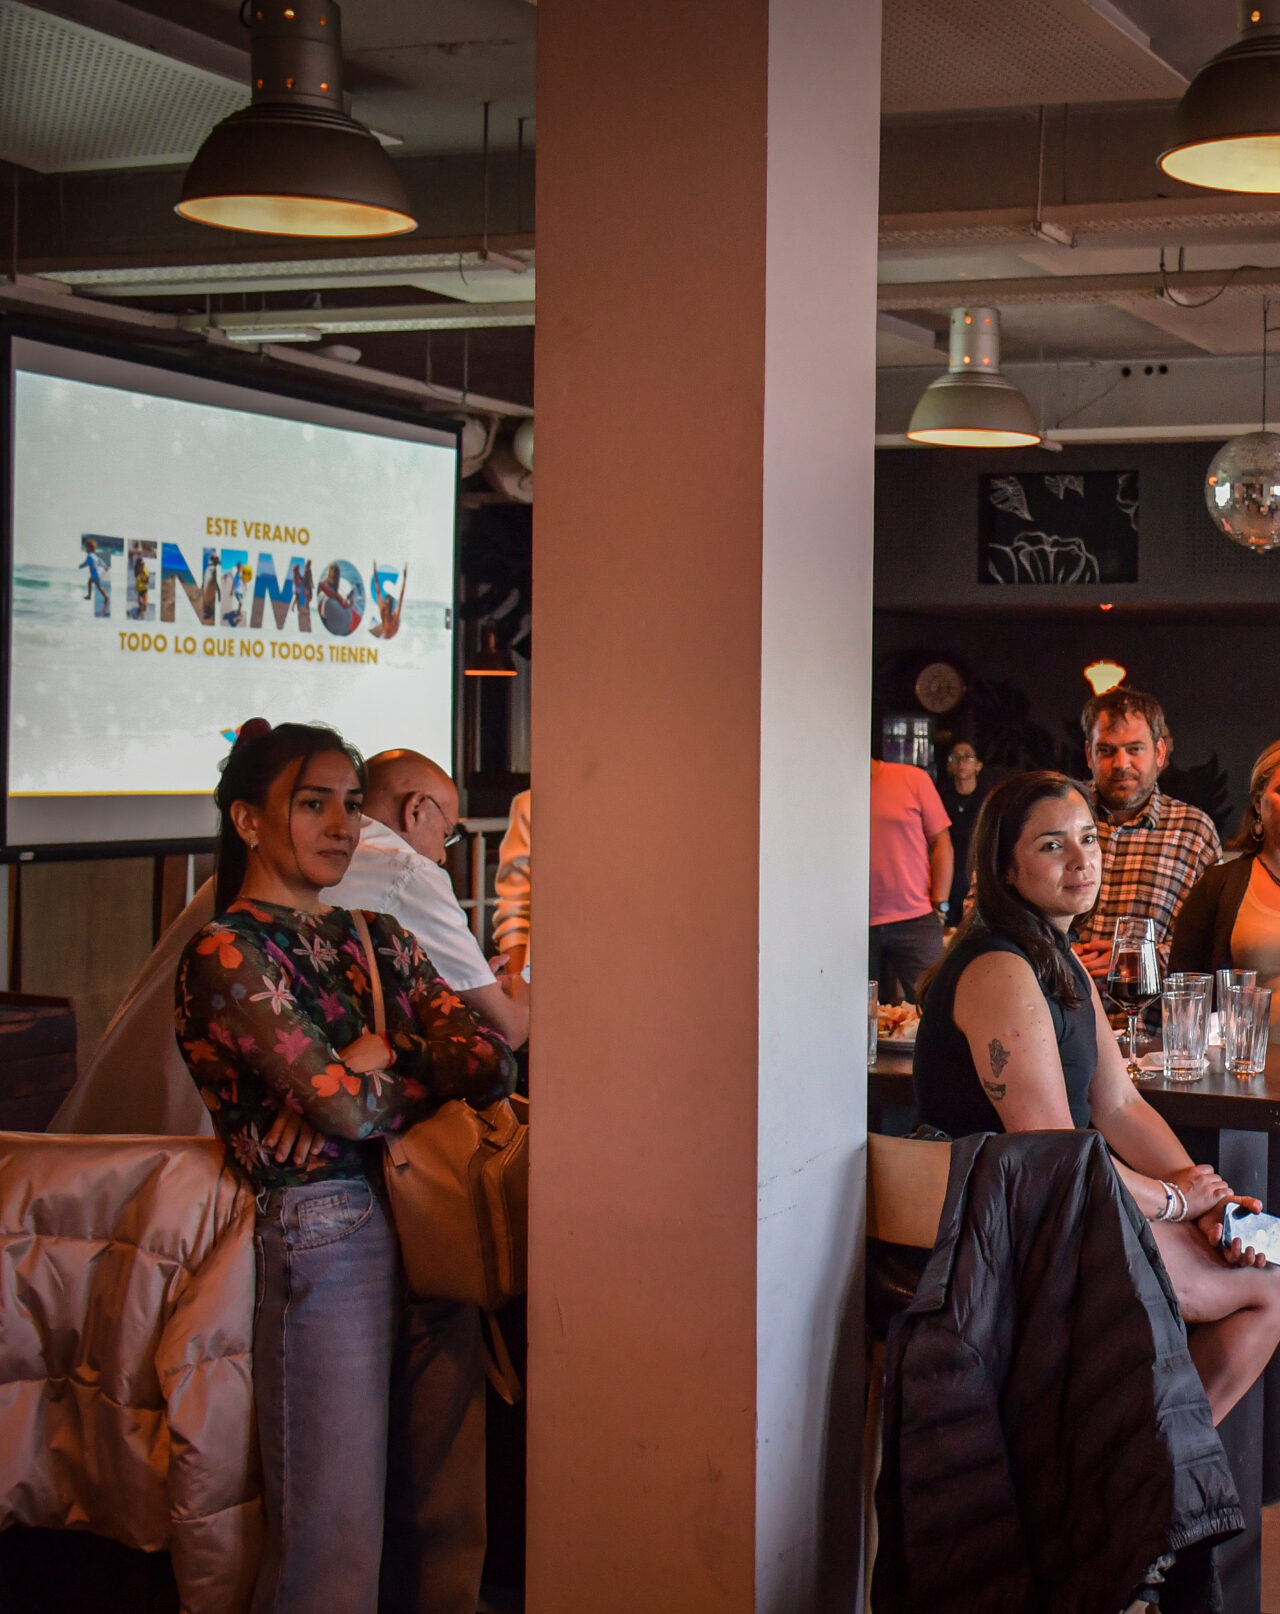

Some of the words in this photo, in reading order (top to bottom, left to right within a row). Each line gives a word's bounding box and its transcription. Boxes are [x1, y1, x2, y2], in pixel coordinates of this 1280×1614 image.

[206, 516, 238, 538] ESTE
[243, 520, 310, 546] VERANO
[80, 533, 408, 640] TENEMOS
[119, 632, 168, 653] TODO
[174, 635, 197, 655] LO
[203, 637, 235, 657] QUE
[240, 639, 265, 658] NO
[269, 641, 325, 662] TODOS
[328, 645, 378, 665] TIENEN
